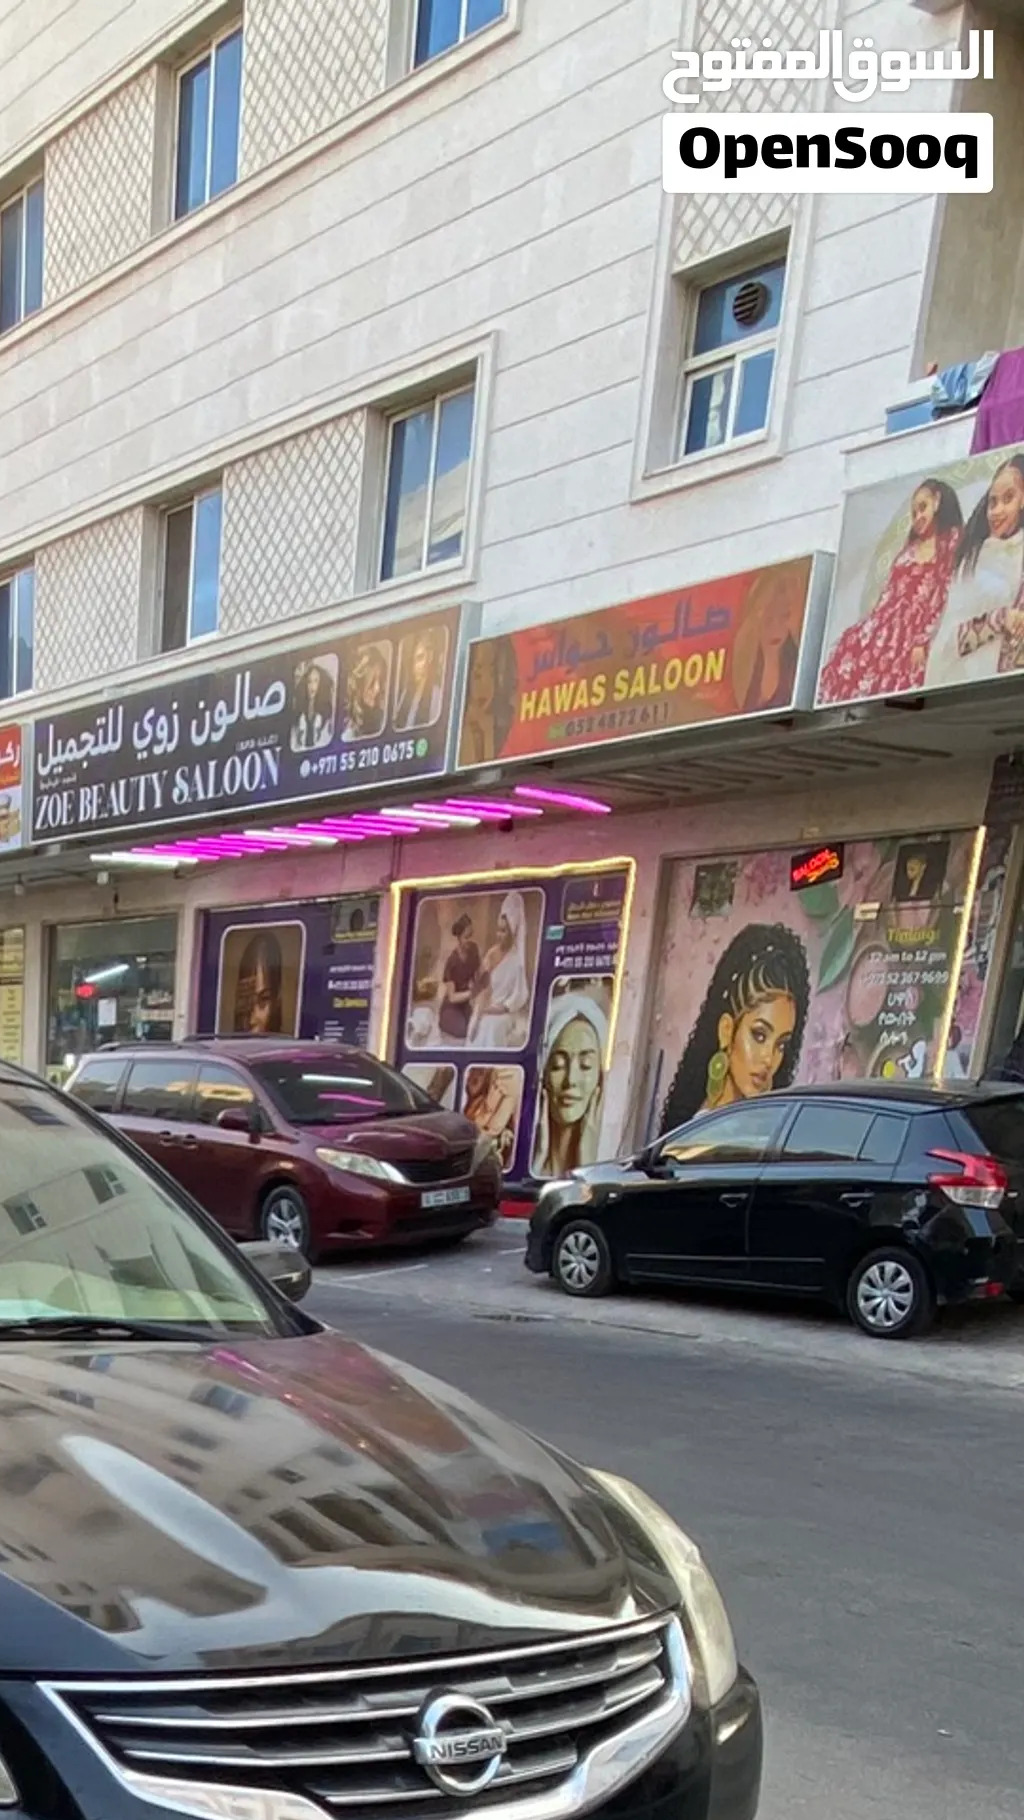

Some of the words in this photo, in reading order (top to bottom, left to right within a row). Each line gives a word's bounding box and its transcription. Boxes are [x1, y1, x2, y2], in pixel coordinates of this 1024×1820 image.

[189, 671, 286, 746] صالون
[519, 673, 607, 722] HAWAS
[612, 648, 726, 702] SALOON
[37, 704, 124, 777] للتجميل
[133, 701, 180, 760] زوي
[311, 757, 337, 776] +971
[338, 753, 355, 772] 55
[357, 747, 379, 769] 210
[381, 739, 414, 765] 0675
[34, 791, 77, 831] ZOE
[78, 768, 169, 824] BEAUTY
[171, 746, 282, 806] SALOON
[429, 1735, 503, 1759] NISSAN
